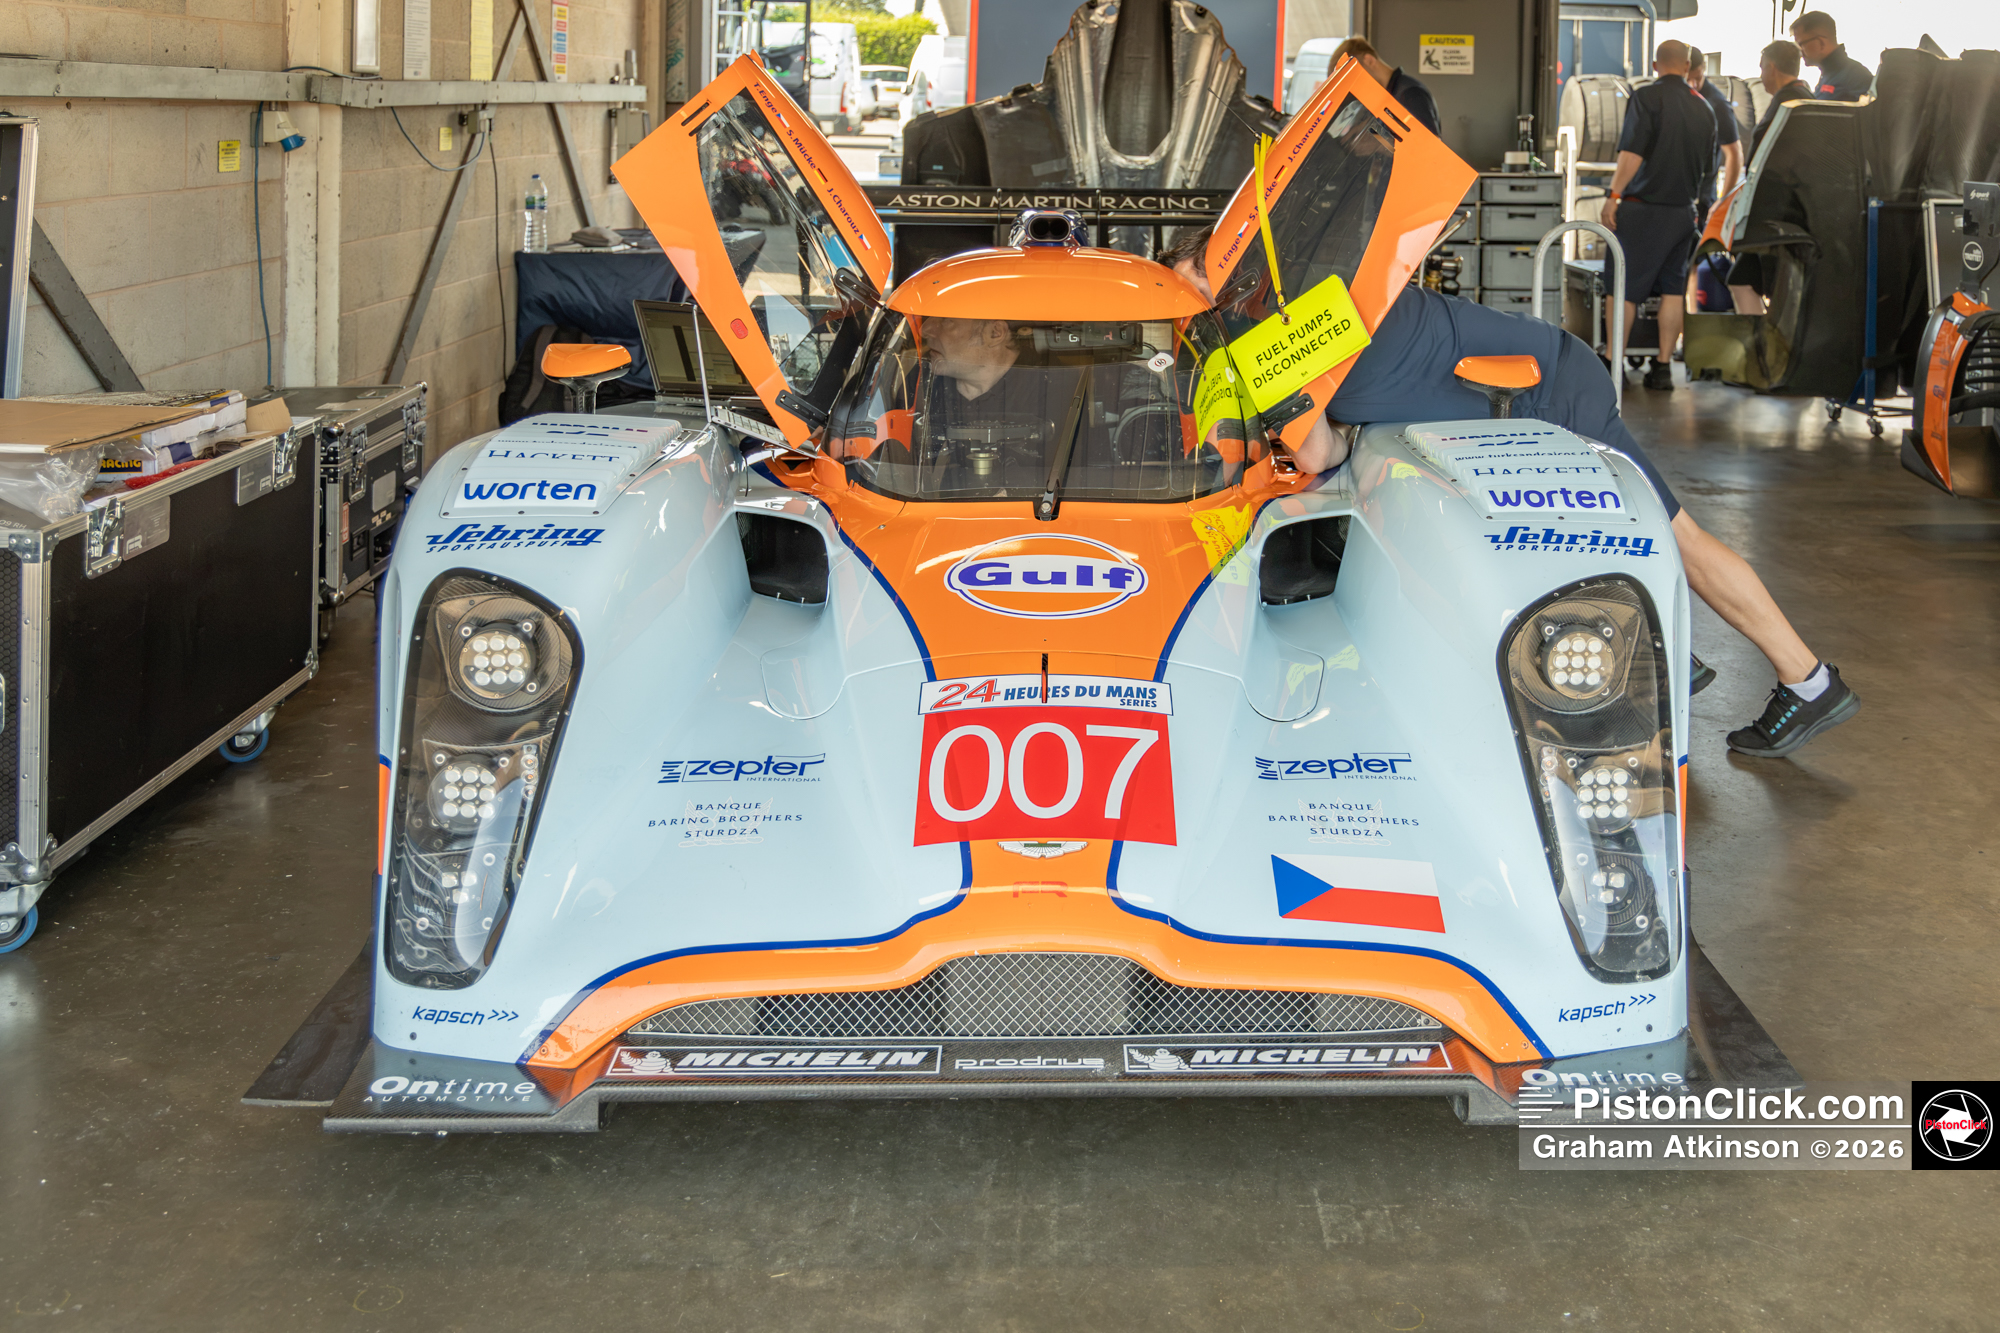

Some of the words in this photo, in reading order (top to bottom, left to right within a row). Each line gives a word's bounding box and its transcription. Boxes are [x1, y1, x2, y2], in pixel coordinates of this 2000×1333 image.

[1428, 37, 1466, 45] CAUTION
[753, 82, 778, 114] T.Enge
[786, 129, 817, 170] S.Mücke
[826, 188, 860, 234] J.Charouz
[887, 194, 981, 207] ASTON
[989, 195, 1093, 209] MARTIN
[1101, 196, 1210, 210] RACING
[1217, 237, 1241, 270] T.Enge
[1248, 180, 1278, 221] S.cke
[1287, 116, 1322, 163] J.Charouz
[1255, 340, 1288, 366] FUEL
[1287, 308, 1332, 345] PUMPS
[1252, 318, 1351, 389] DISCONNECTED
[463, 480, 597, 500] worten
[1488, 487, 1621, 509] worten
[426, 523, 606, 547] Sebring
[1484, 526, 1660, 557] Sebring
[426, 540, 571, 554] SPORTAUSPUFF
[1494, 544, 1630, 556] SPORTAUSPUFF
[958, 562, 1135, 589] Gulf
[930, 679, 1001, 710] 24
[1074, 685, 1101, 699] DU
[1105, 685, 1157, 700] MANS
[1120, 698, 1157, 708] SERIES
[687, 755, 825, 781] zepter
[928, 722, 1159, 822] 007
[1277, 753, 1412, 779] zepter
[695, 802, 762, 811] BANQUE
[1308, 803, 1374, 811] BANQUE
[648, 816, 710, 827] BARING
[718, 814, 803, 823] BROTHERS
[1337, 815, 1419, 826] BROTHERS
[684, 828, 759, 838] STURDZA
[1310, 827, 1383, 837] STURDZA
[411, 1006, 485, 1025] kapsch
[1558, 1001, 1625, 1022] kapsch
[674, 1052, 929, 1067] MICHELIN
[955, 1056, 1104, 1070] prodrive
[1189, 1048, 1432, 1064] MICHELIN
[370, 1076, 536, 1095] Ontime
[1521, 1069, 1684, 1086] Ontime
